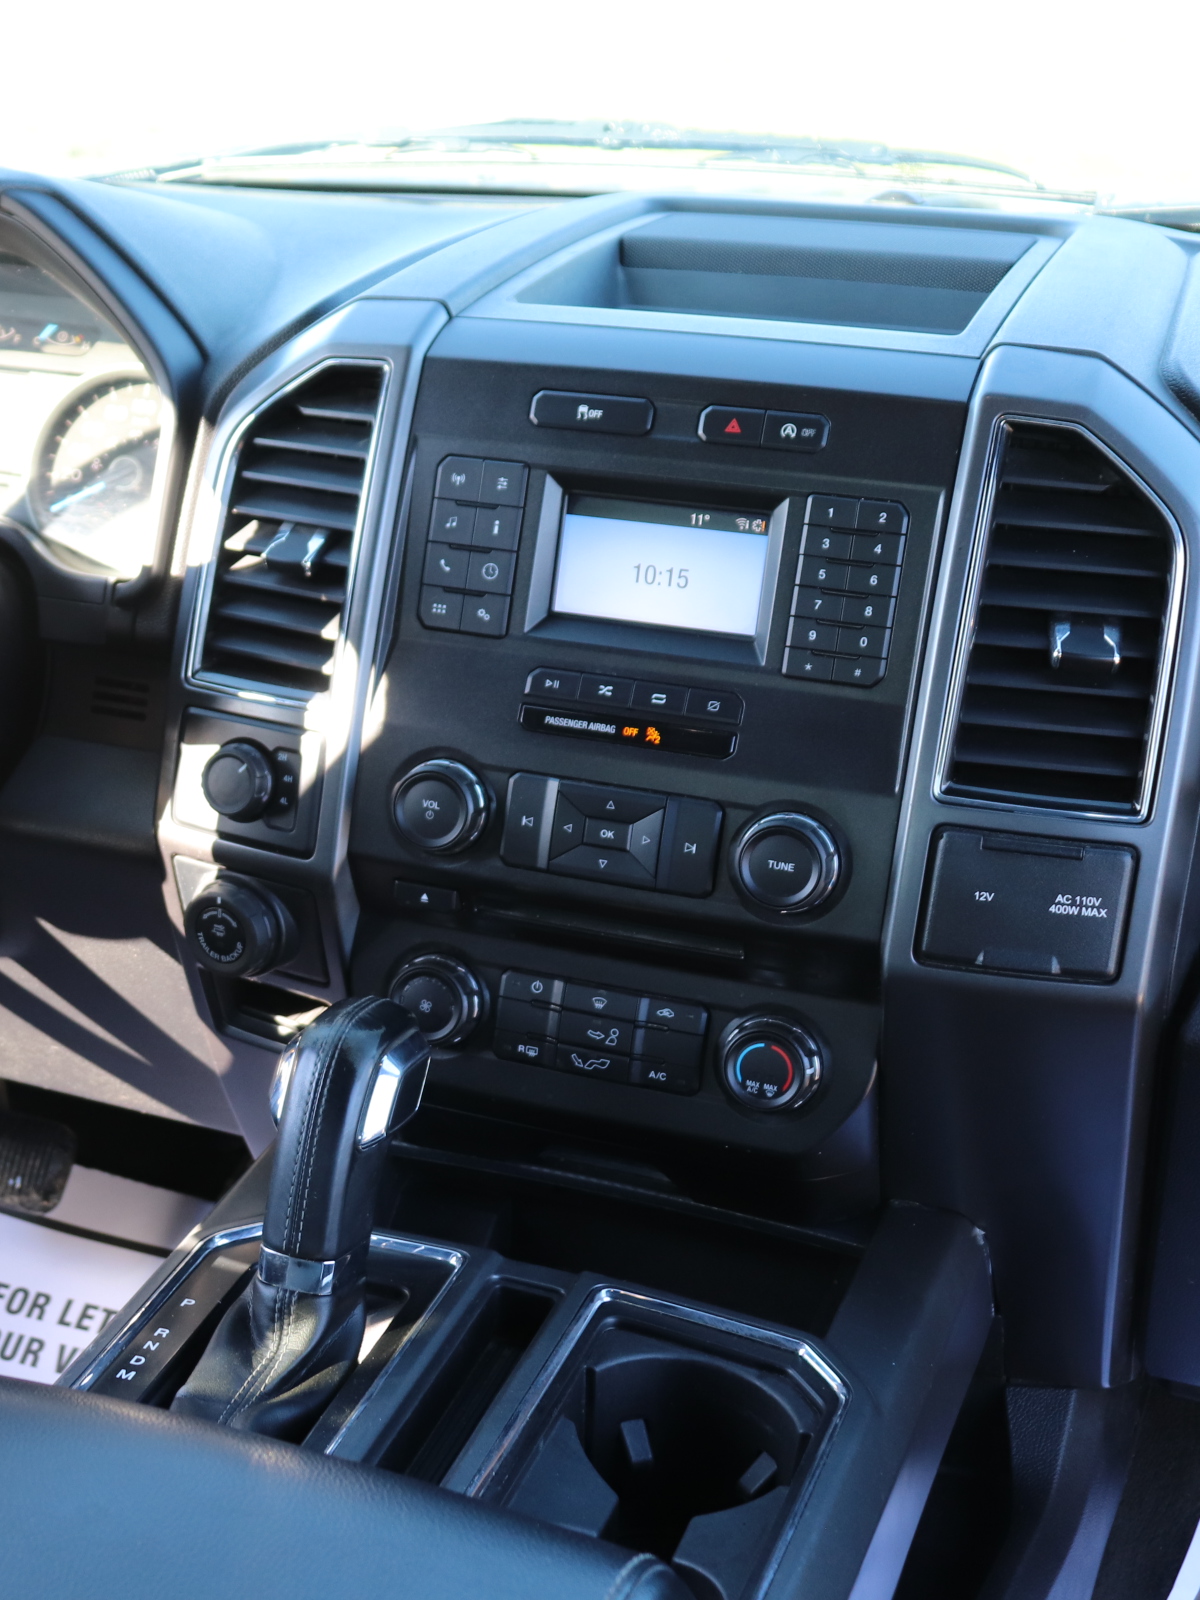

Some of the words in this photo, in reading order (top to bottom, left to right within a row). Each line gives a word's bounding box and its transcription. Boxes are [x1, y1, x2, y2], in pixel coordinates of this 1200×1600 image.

[588, 408, 603, 418] OFF
[801, 428, 816, 438] OFF
[828, 507, 834, 518] 1
[878, 512, 887, 523] 2
[822, 538, 830, 549] 3
[874, 543, 882, 554] 4
[633, 562, 690, 589] 10:15
[818, 569, 826, 580] 5
[870, 575, 878, 586] 6
[814, 600, 822, 610] 7
[864, 606, 873, 616] 8
[808, 630, 817, 640] 9
[859, 636, 868, 647] 0
[544, 715, 588, 729] PASSENGER
[588, 722, 616, 734] AIRBAG
[622, 726, 639, 738] OFF
[278, 752, 288, 761] 2H
[283, 774, 293, 783] 4H
[280, 796, 288, 805] 4L
[422, 799, 440, 810] VOL
[600, 829, 615, 839] OK
[768, 860, 796, 872] TUNE
[974, 890, 995, 902] 12V
[1055, 894, 1072, 904] AC
[1074, 895, 1102, 907] 110V
[1048, 904, 1081, 916] 400W
[1081, 907, 1108, 919] MAX
[197, 932, 220, 960] TRAILER
[220, 942, 244, 962] BACKUP
[518, 1044, 525, 1053] R
[648, 1070, 667, 1081] A/C
[746, 1080, 760, 1088] MAX
[763, 1083, 778, 1092] MAX
[746, 1086, 758, 1094] A/C
[180, 1298, 196, 1307] P
[154, 1327, 170, 1338] R
[142, 1340, 160, 1351] N
[129, 1355, 146, 1366] D
[116, 1368, 137, 1381] M
